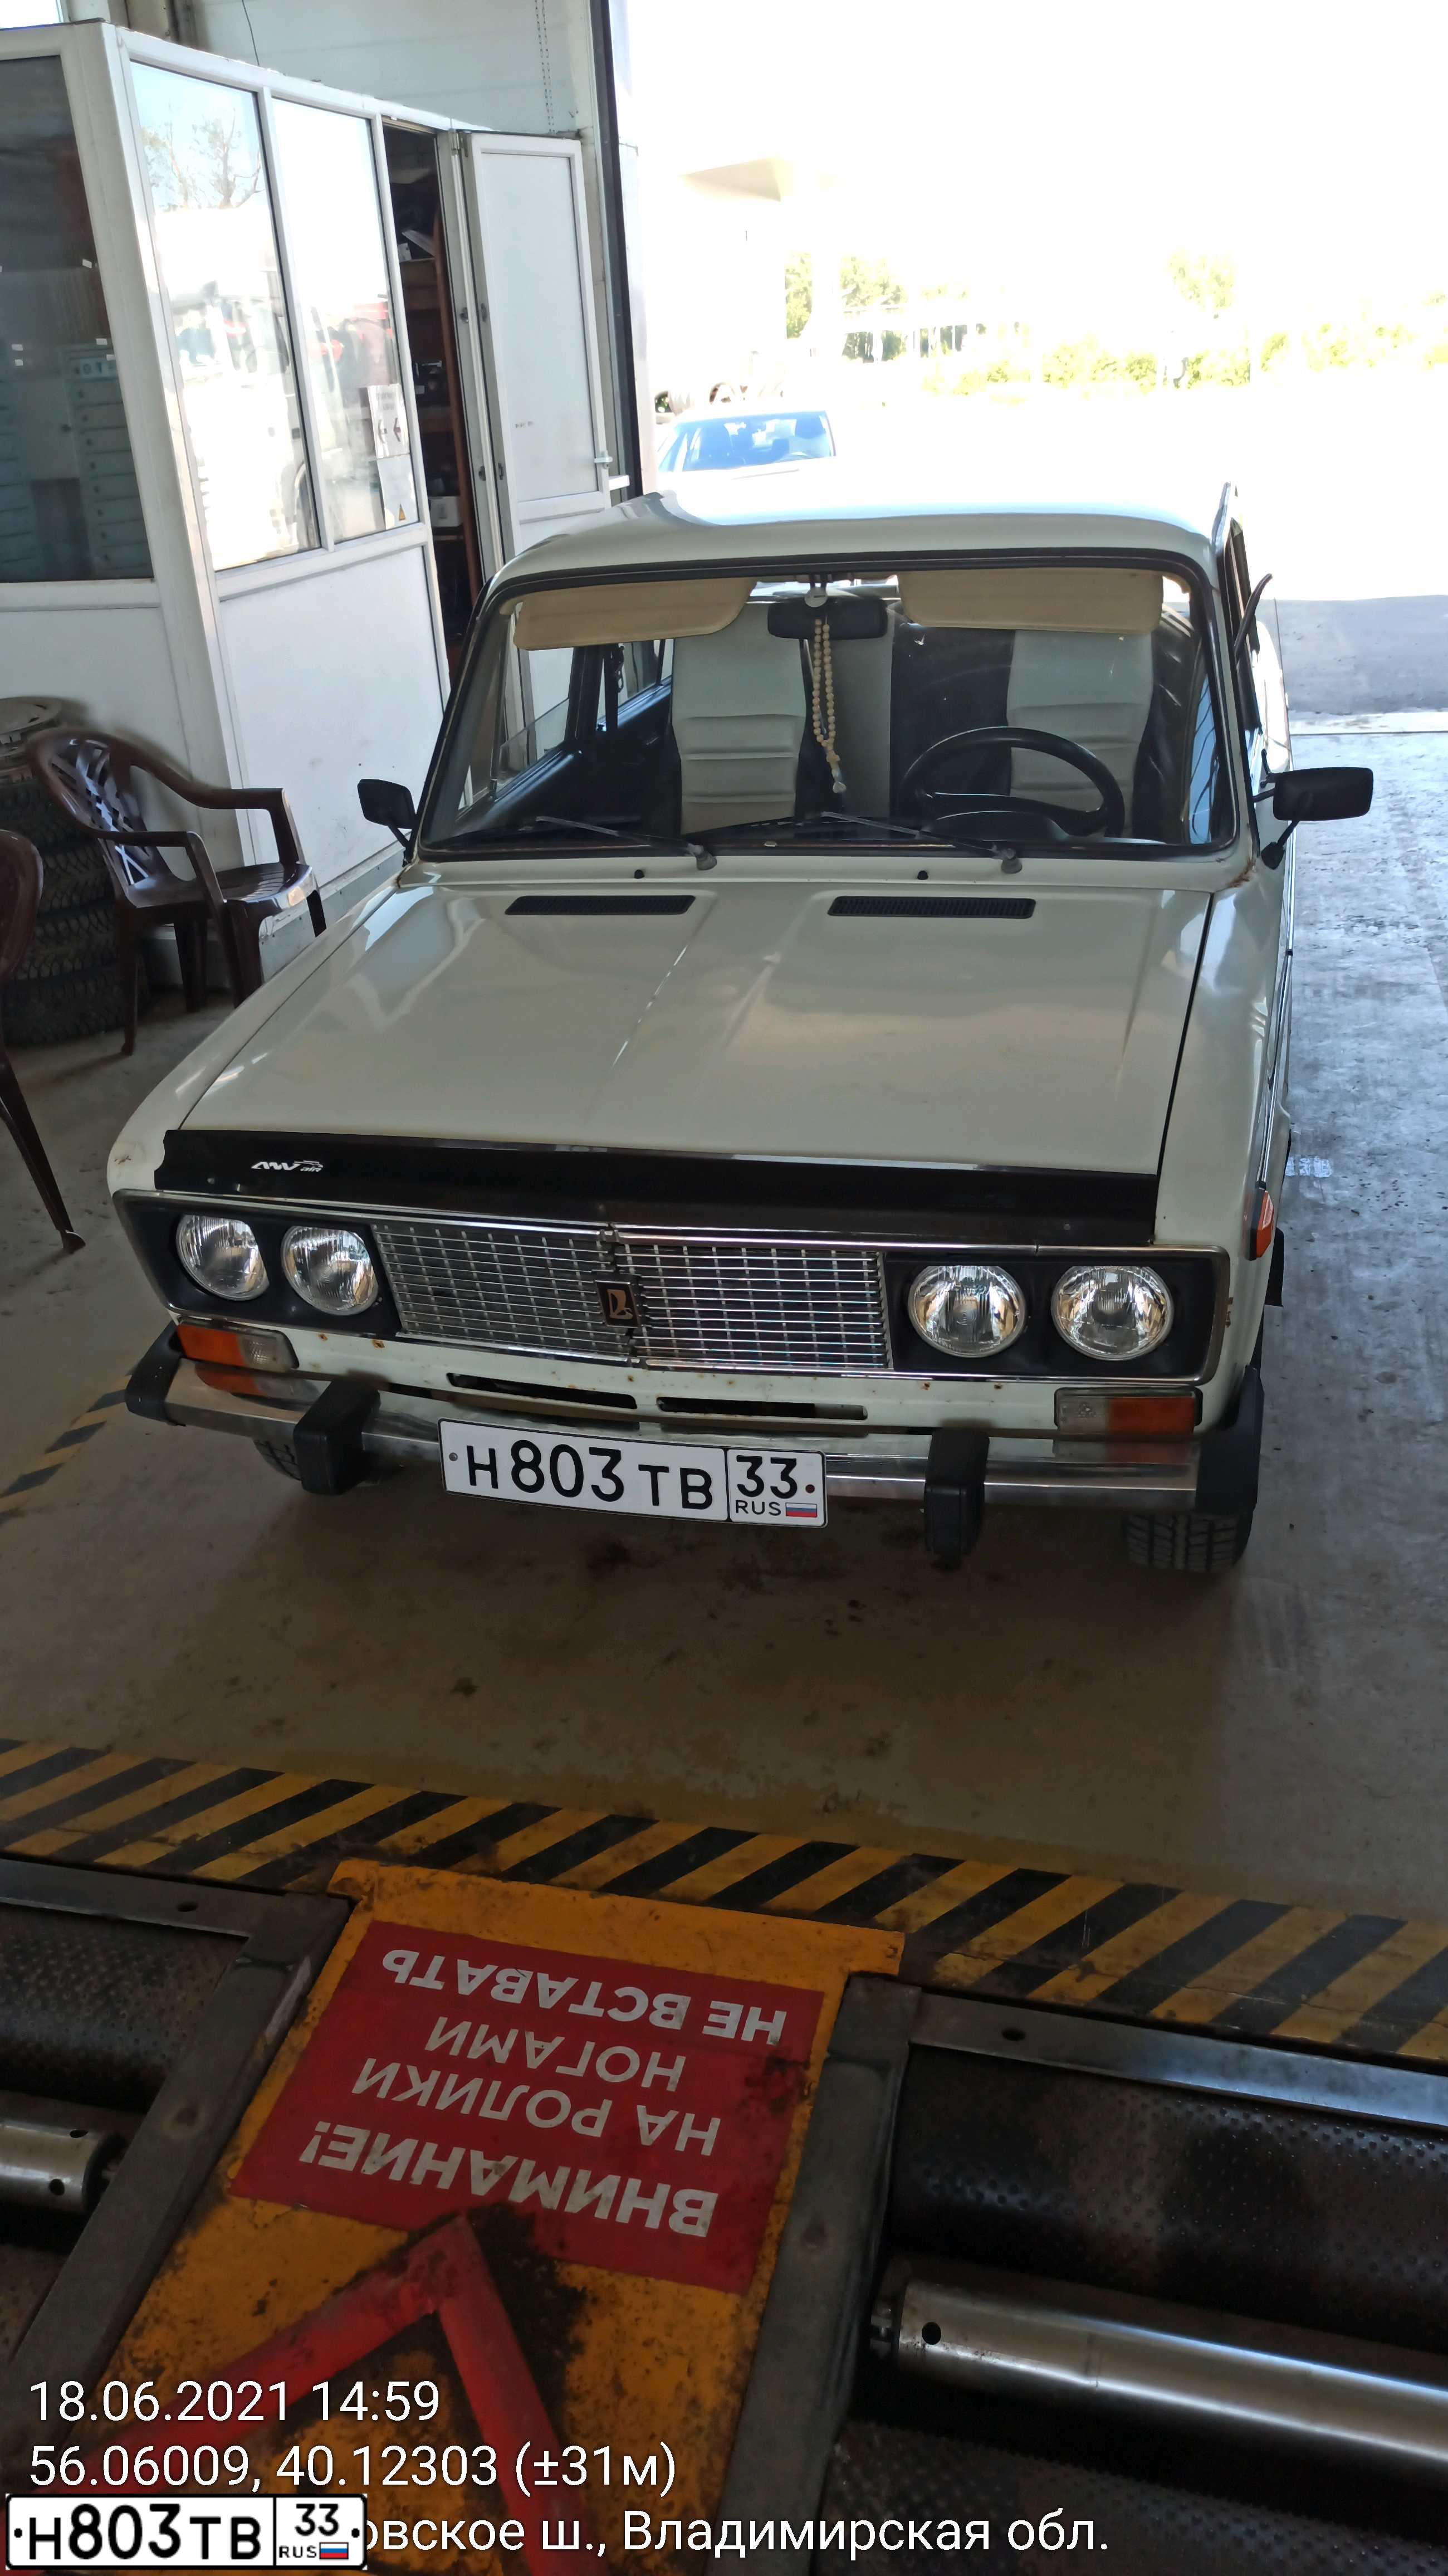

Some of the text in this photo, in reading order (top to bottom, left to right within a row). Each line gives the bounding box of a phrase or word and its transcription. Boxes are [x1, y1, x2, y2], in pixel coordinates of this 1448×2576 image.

[735, 1500, 781, 1516] RUS
[736, 1455, 798, 1500] 33
[382, 1949, 787, 2045] НЕ ВСТАВАТЬ
[424, 2016, 687, 2092] НОГАМИ
[351, 2057, 721, 2157] НА РОЛИКИ
[299, 2120, 719, 2238] ВНИМАНИЕ!
